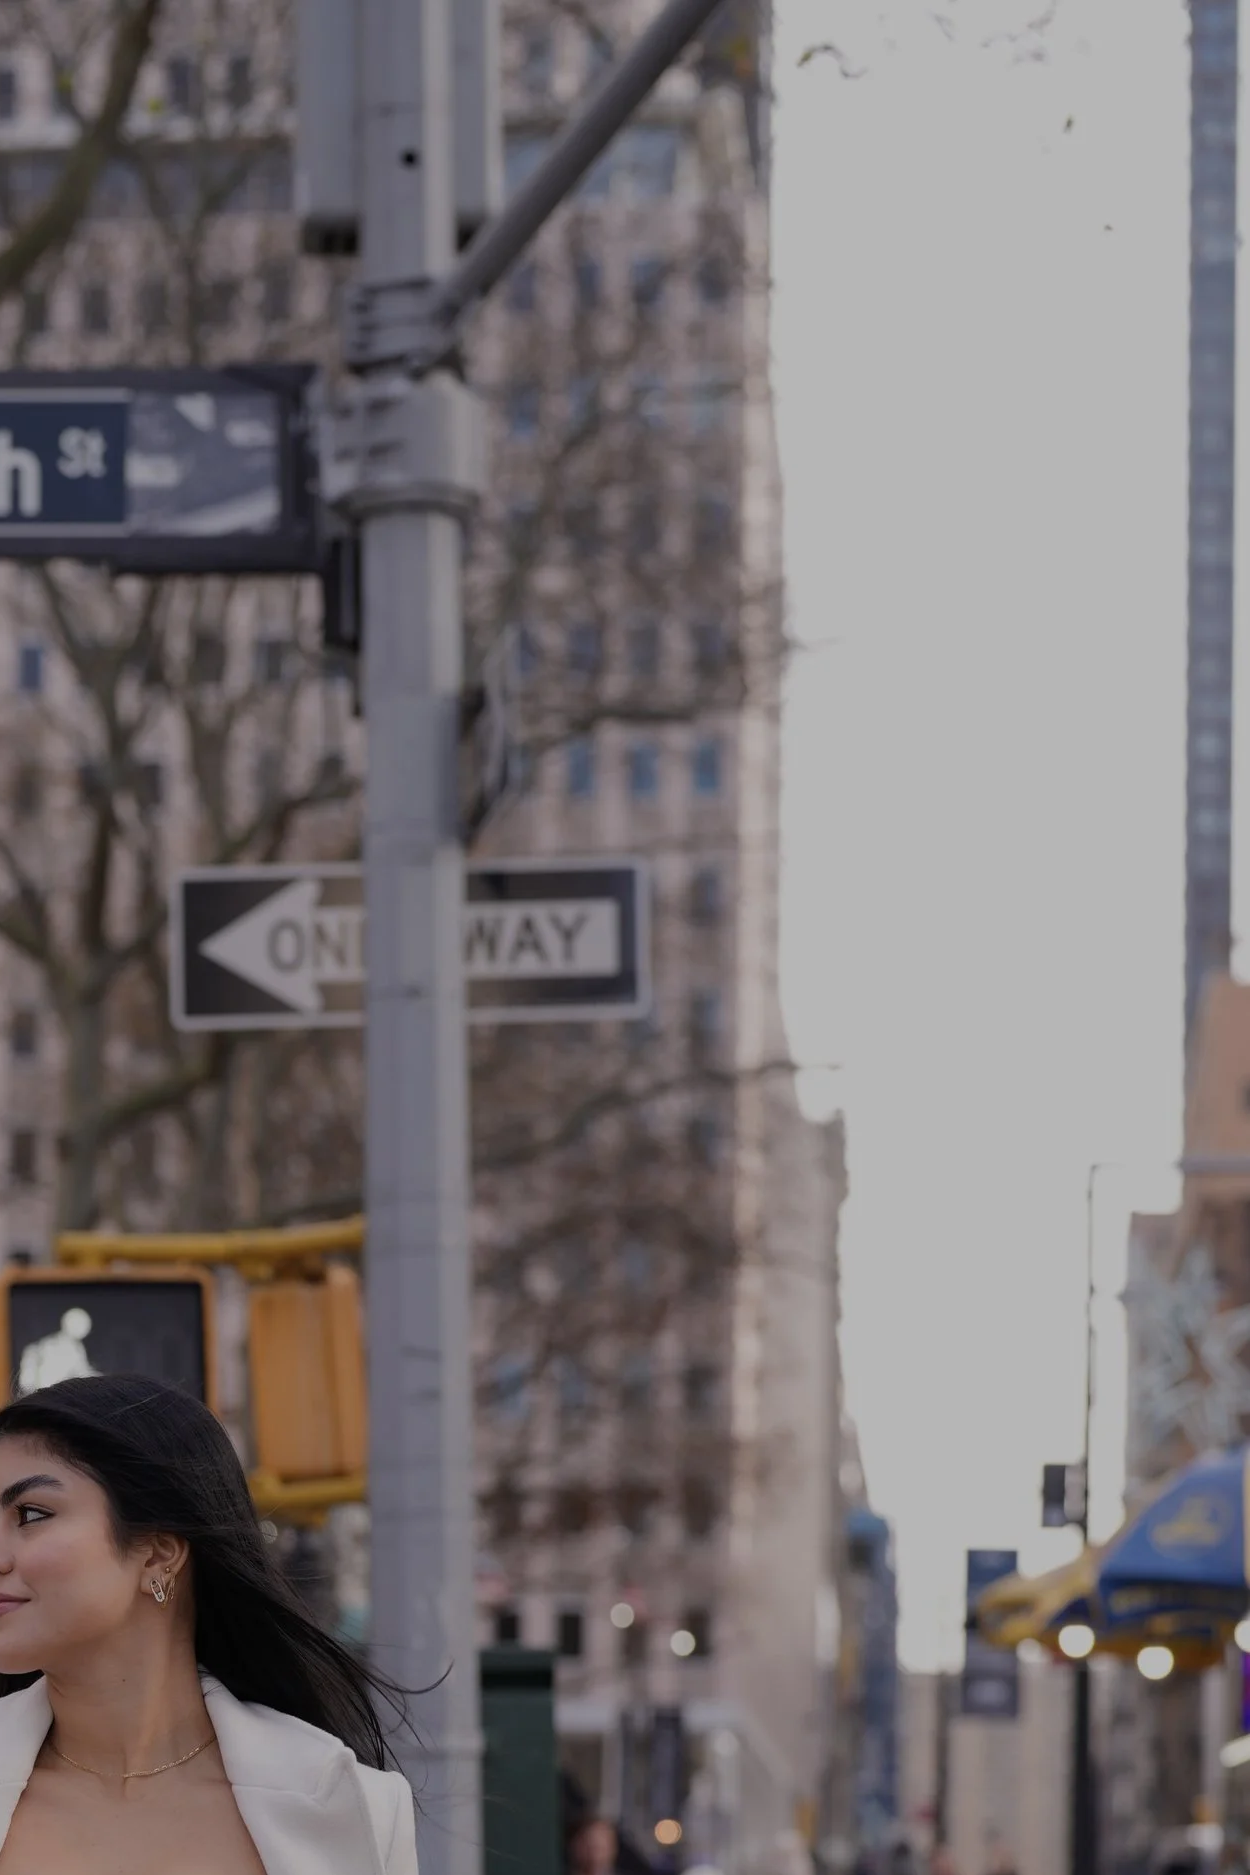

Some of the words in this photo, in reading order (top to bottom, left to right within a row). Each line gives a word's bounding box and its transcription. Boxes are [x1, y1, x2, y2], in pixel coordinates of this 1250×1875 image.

[58, 427, 107, 477] St
[266, 919, 364, 972] ON
[463, 912, 588, 965] WAY
